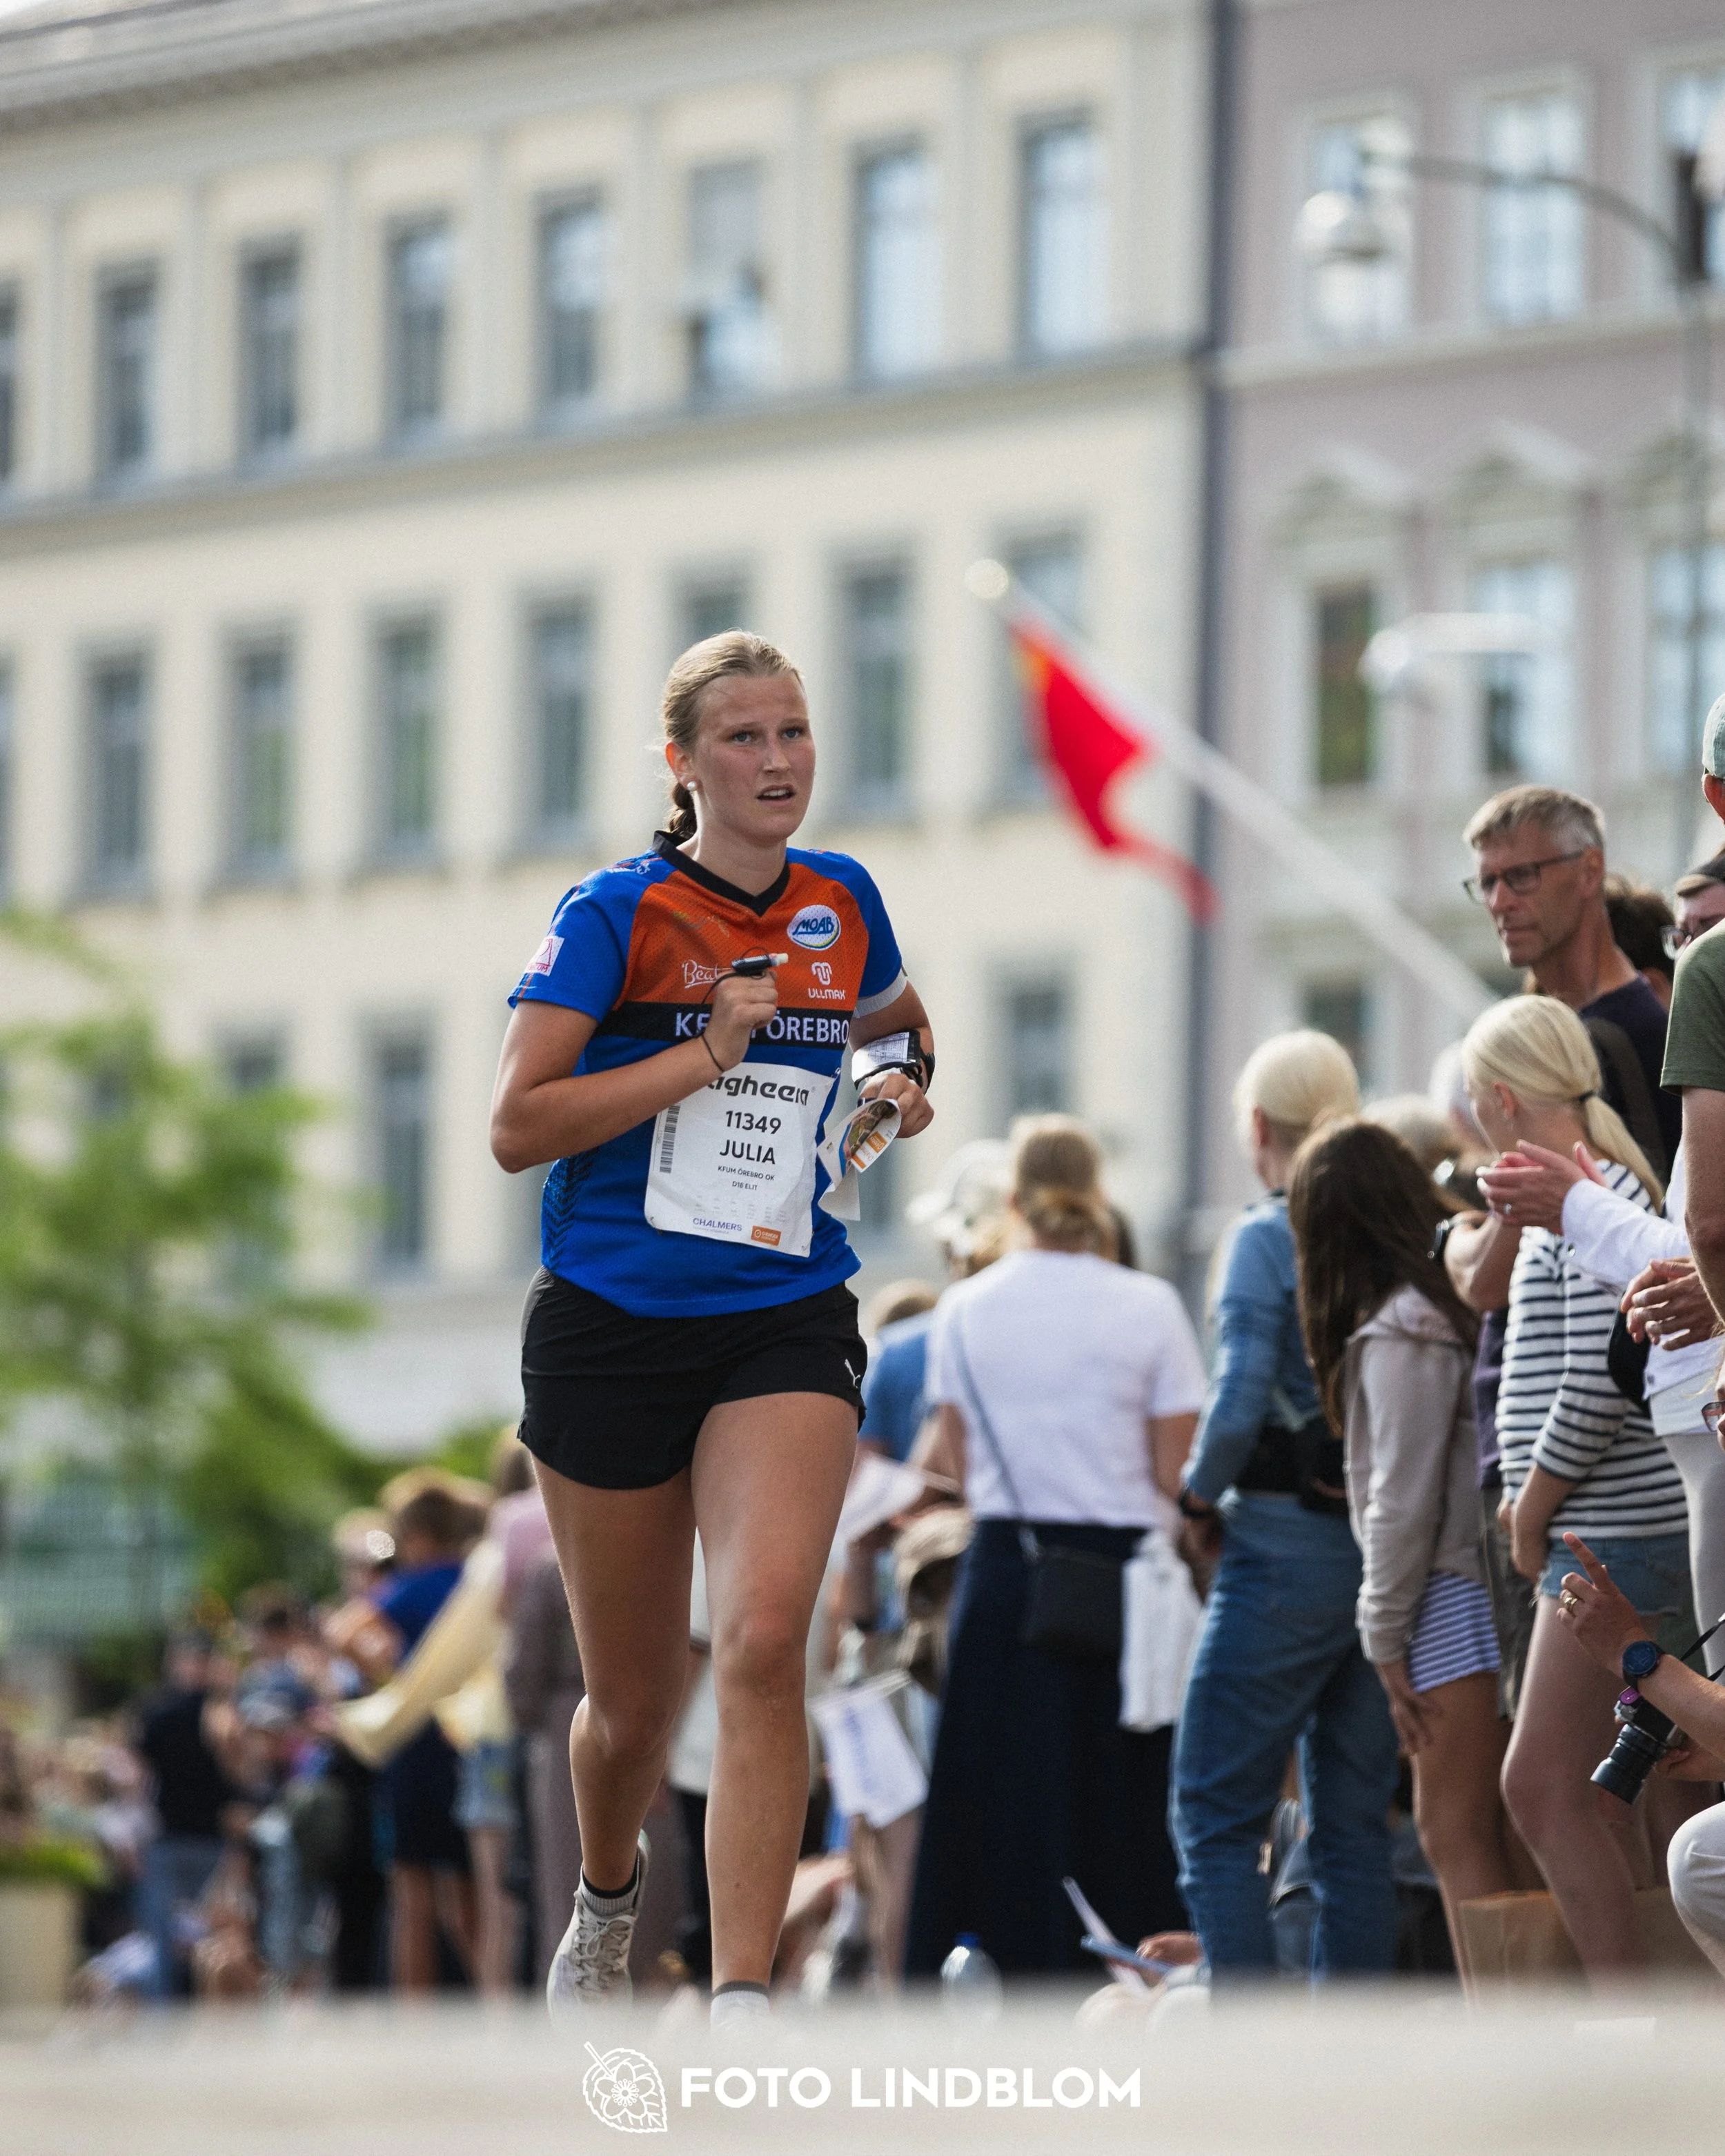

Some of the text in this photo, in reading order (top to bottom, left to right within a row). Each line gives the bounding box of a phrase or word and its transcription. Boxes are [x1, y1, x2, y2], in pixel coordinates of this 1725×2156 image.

[792, 916, 835, 936] MOAB
[808, 987, 846, 1000] ULLMAX
[766, 1010, 849, 1044] ÖREBRO
[726, 1110, 782, 1135] 11349
[719, 1139, 776, 1165] JULIA
[718, 1165, 736, 1174] KFUM
[738, 1167, 764, 1179] ÖREBRO
[745, 1183, 758, 1191] ELIT
[693, 1217, 742, 1232] CHALMERS
